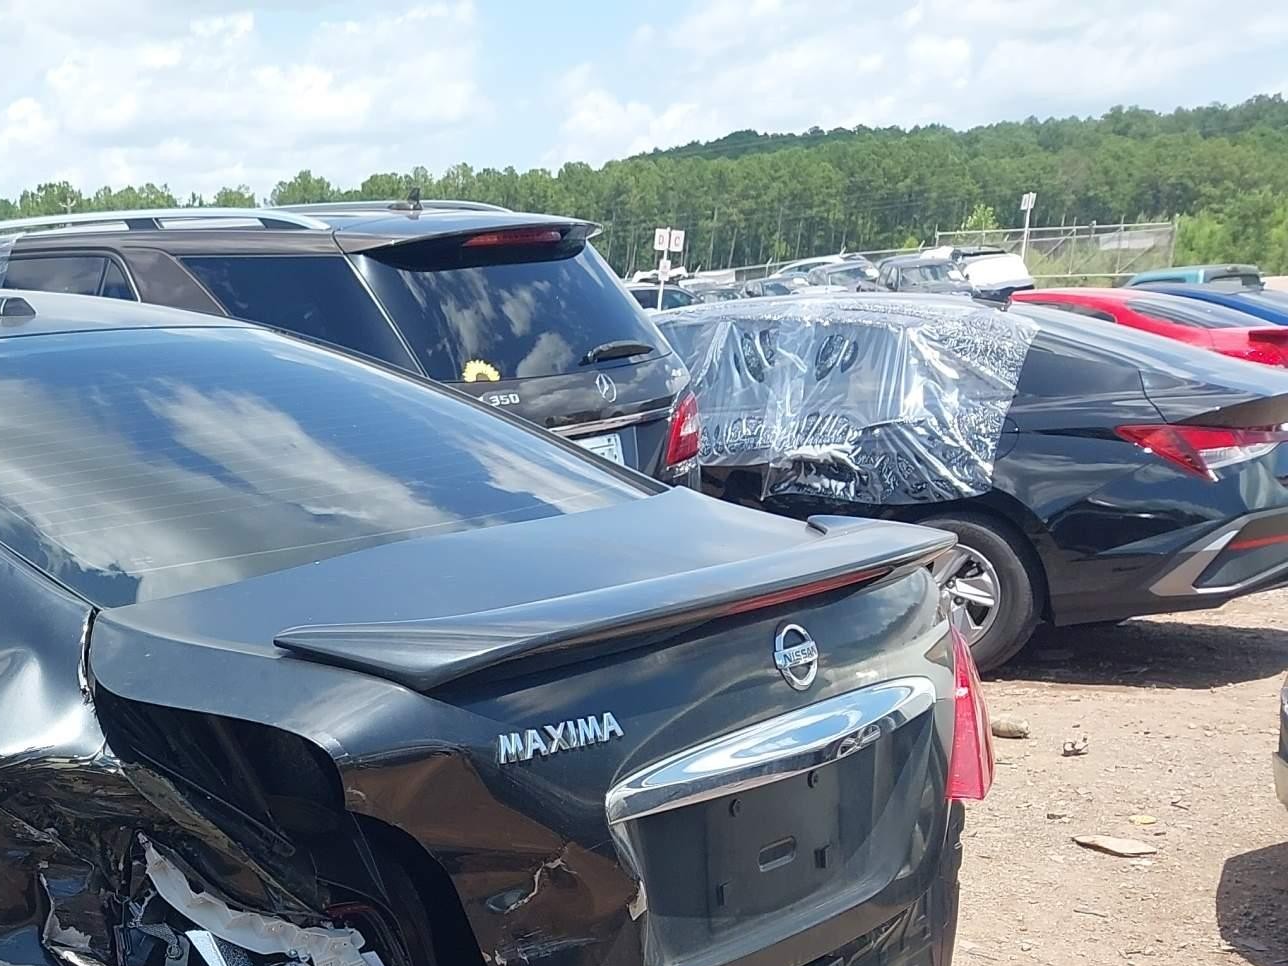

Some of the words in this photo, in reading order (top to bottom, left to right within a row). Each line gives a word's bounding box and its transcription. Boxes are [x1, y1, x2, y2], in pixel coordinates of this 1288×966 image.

[488, 393, 521, 407] 350
[783, 646, 817, 664] NISSAN
[497, 711, 625, 764] MAXIMA
